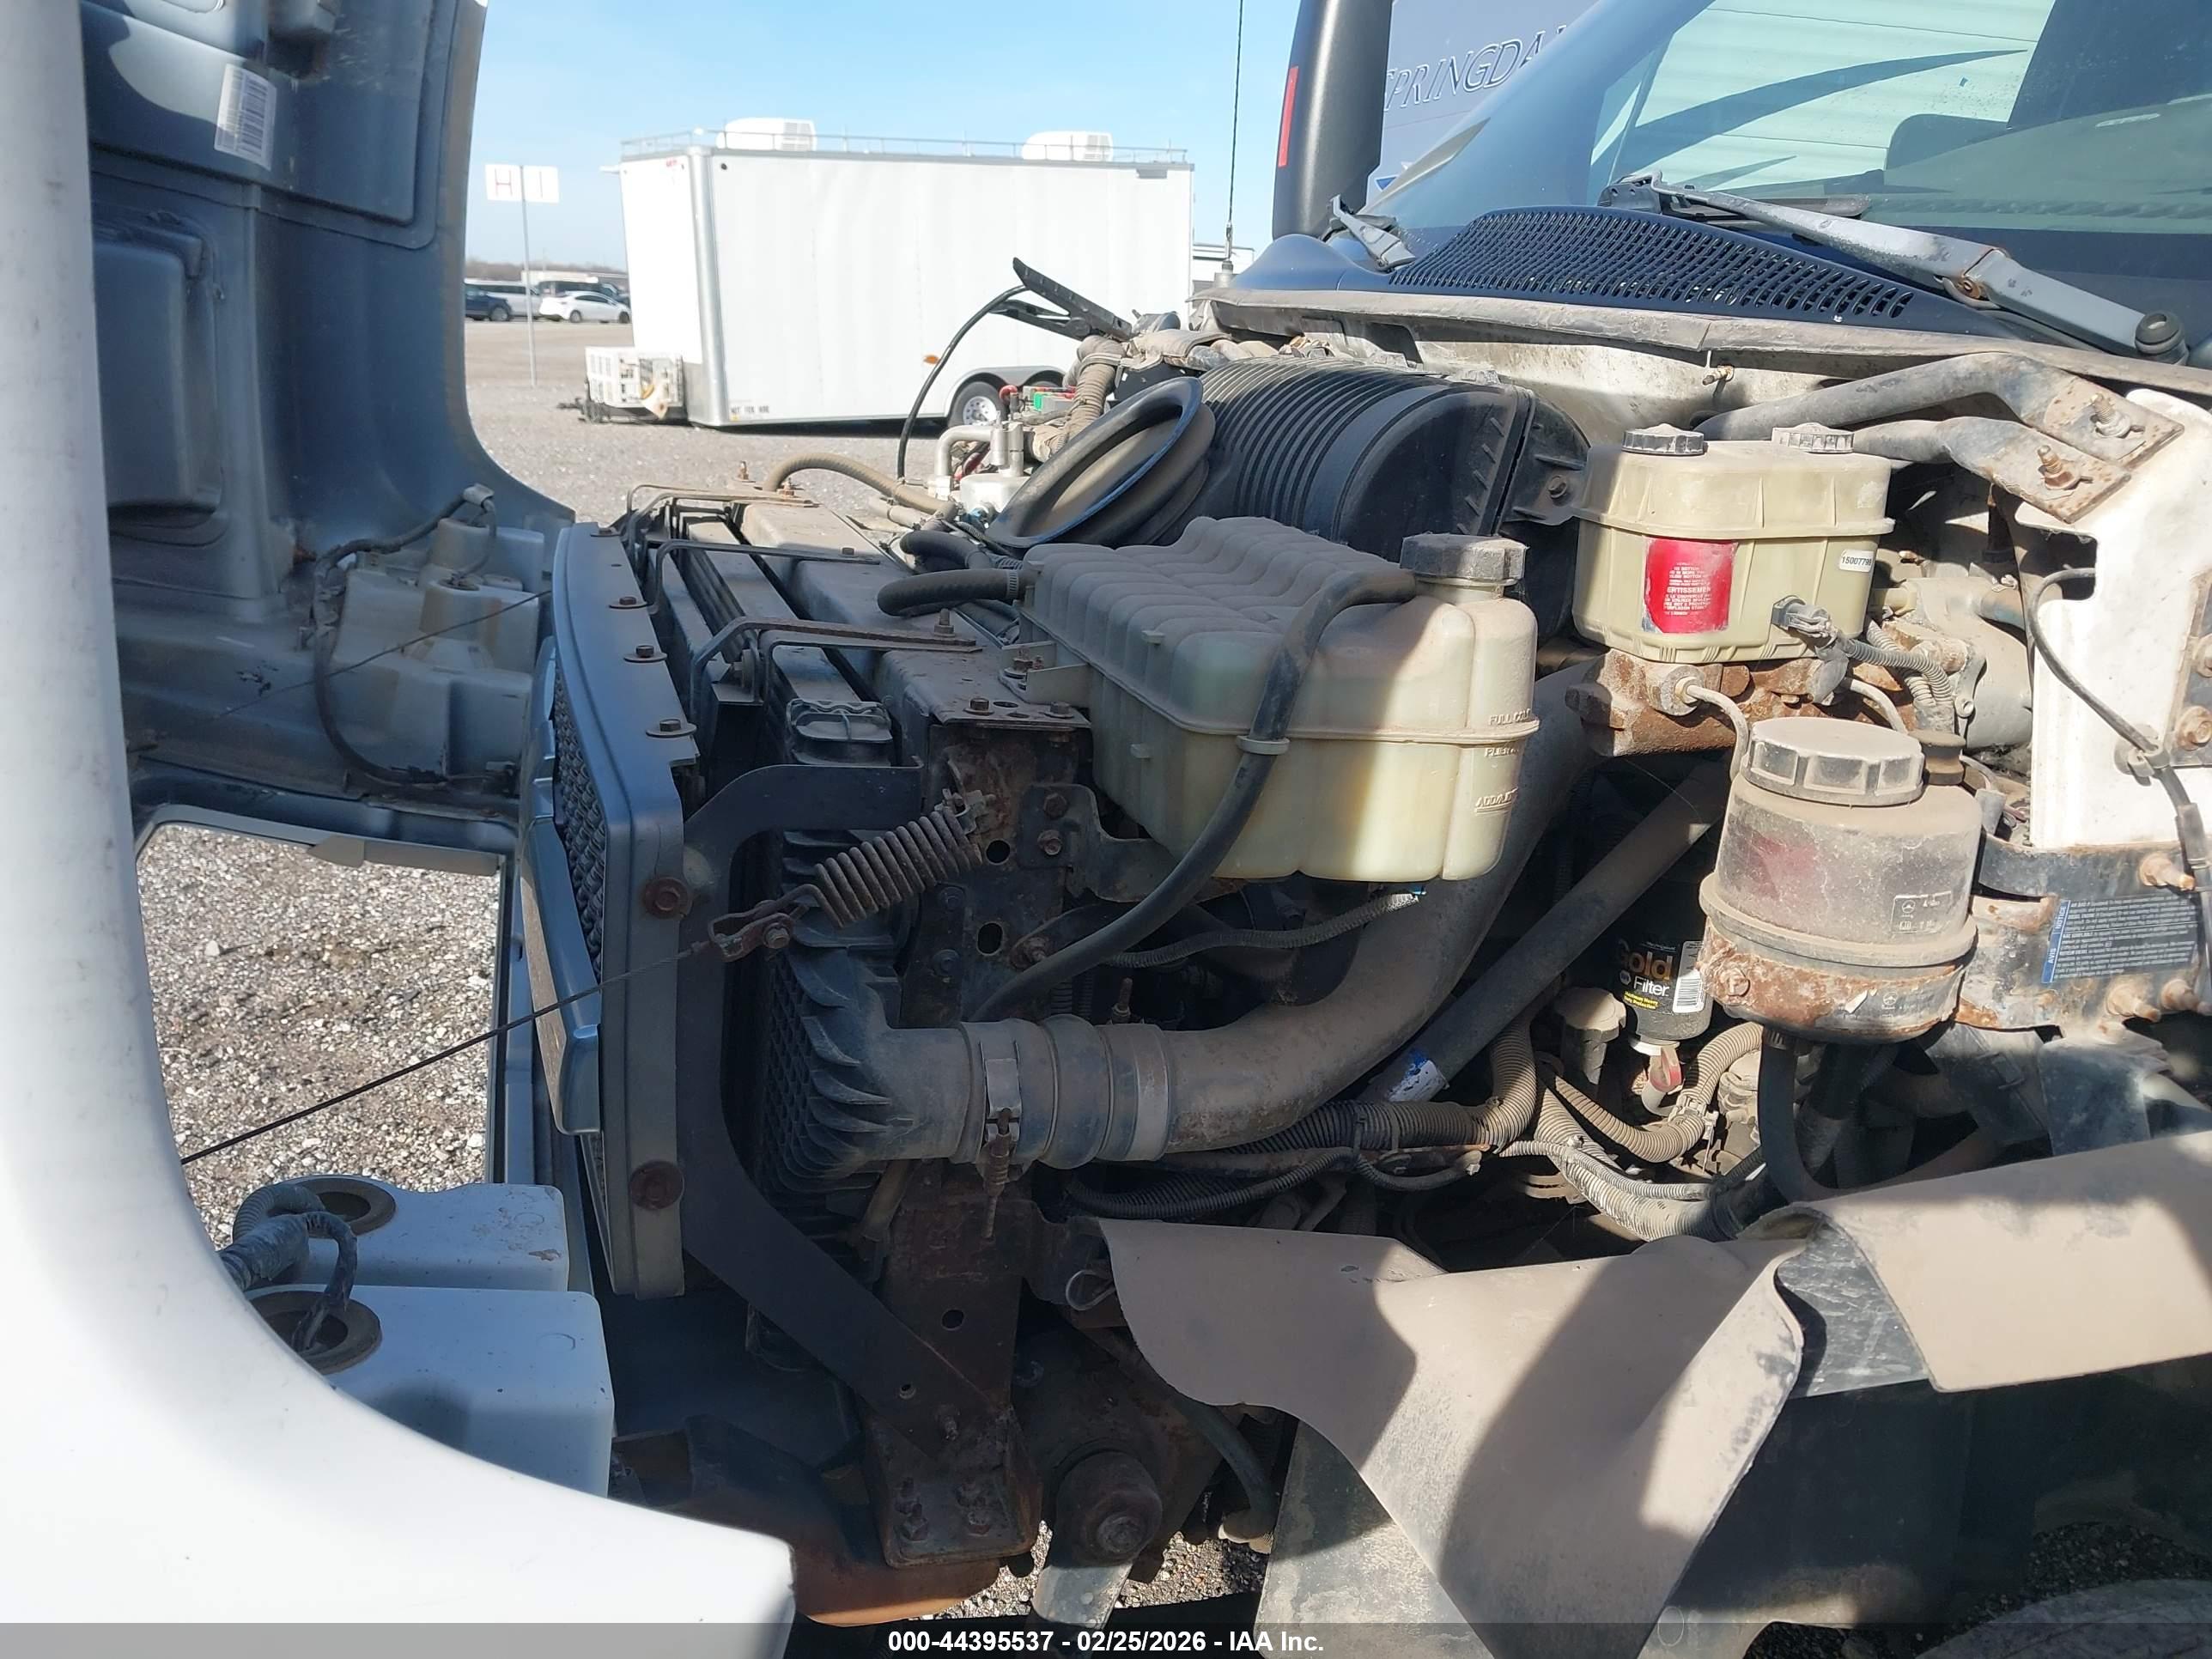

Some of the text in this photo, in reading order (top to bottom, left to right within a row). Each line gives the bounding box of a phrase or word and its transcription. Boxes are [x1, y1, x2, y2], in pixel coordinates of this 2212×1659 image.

[495, 167, 514, 198] H
[2055, 905, 2068, 930] NOTICE
[2047, 947, 2057, 964] AVIS
